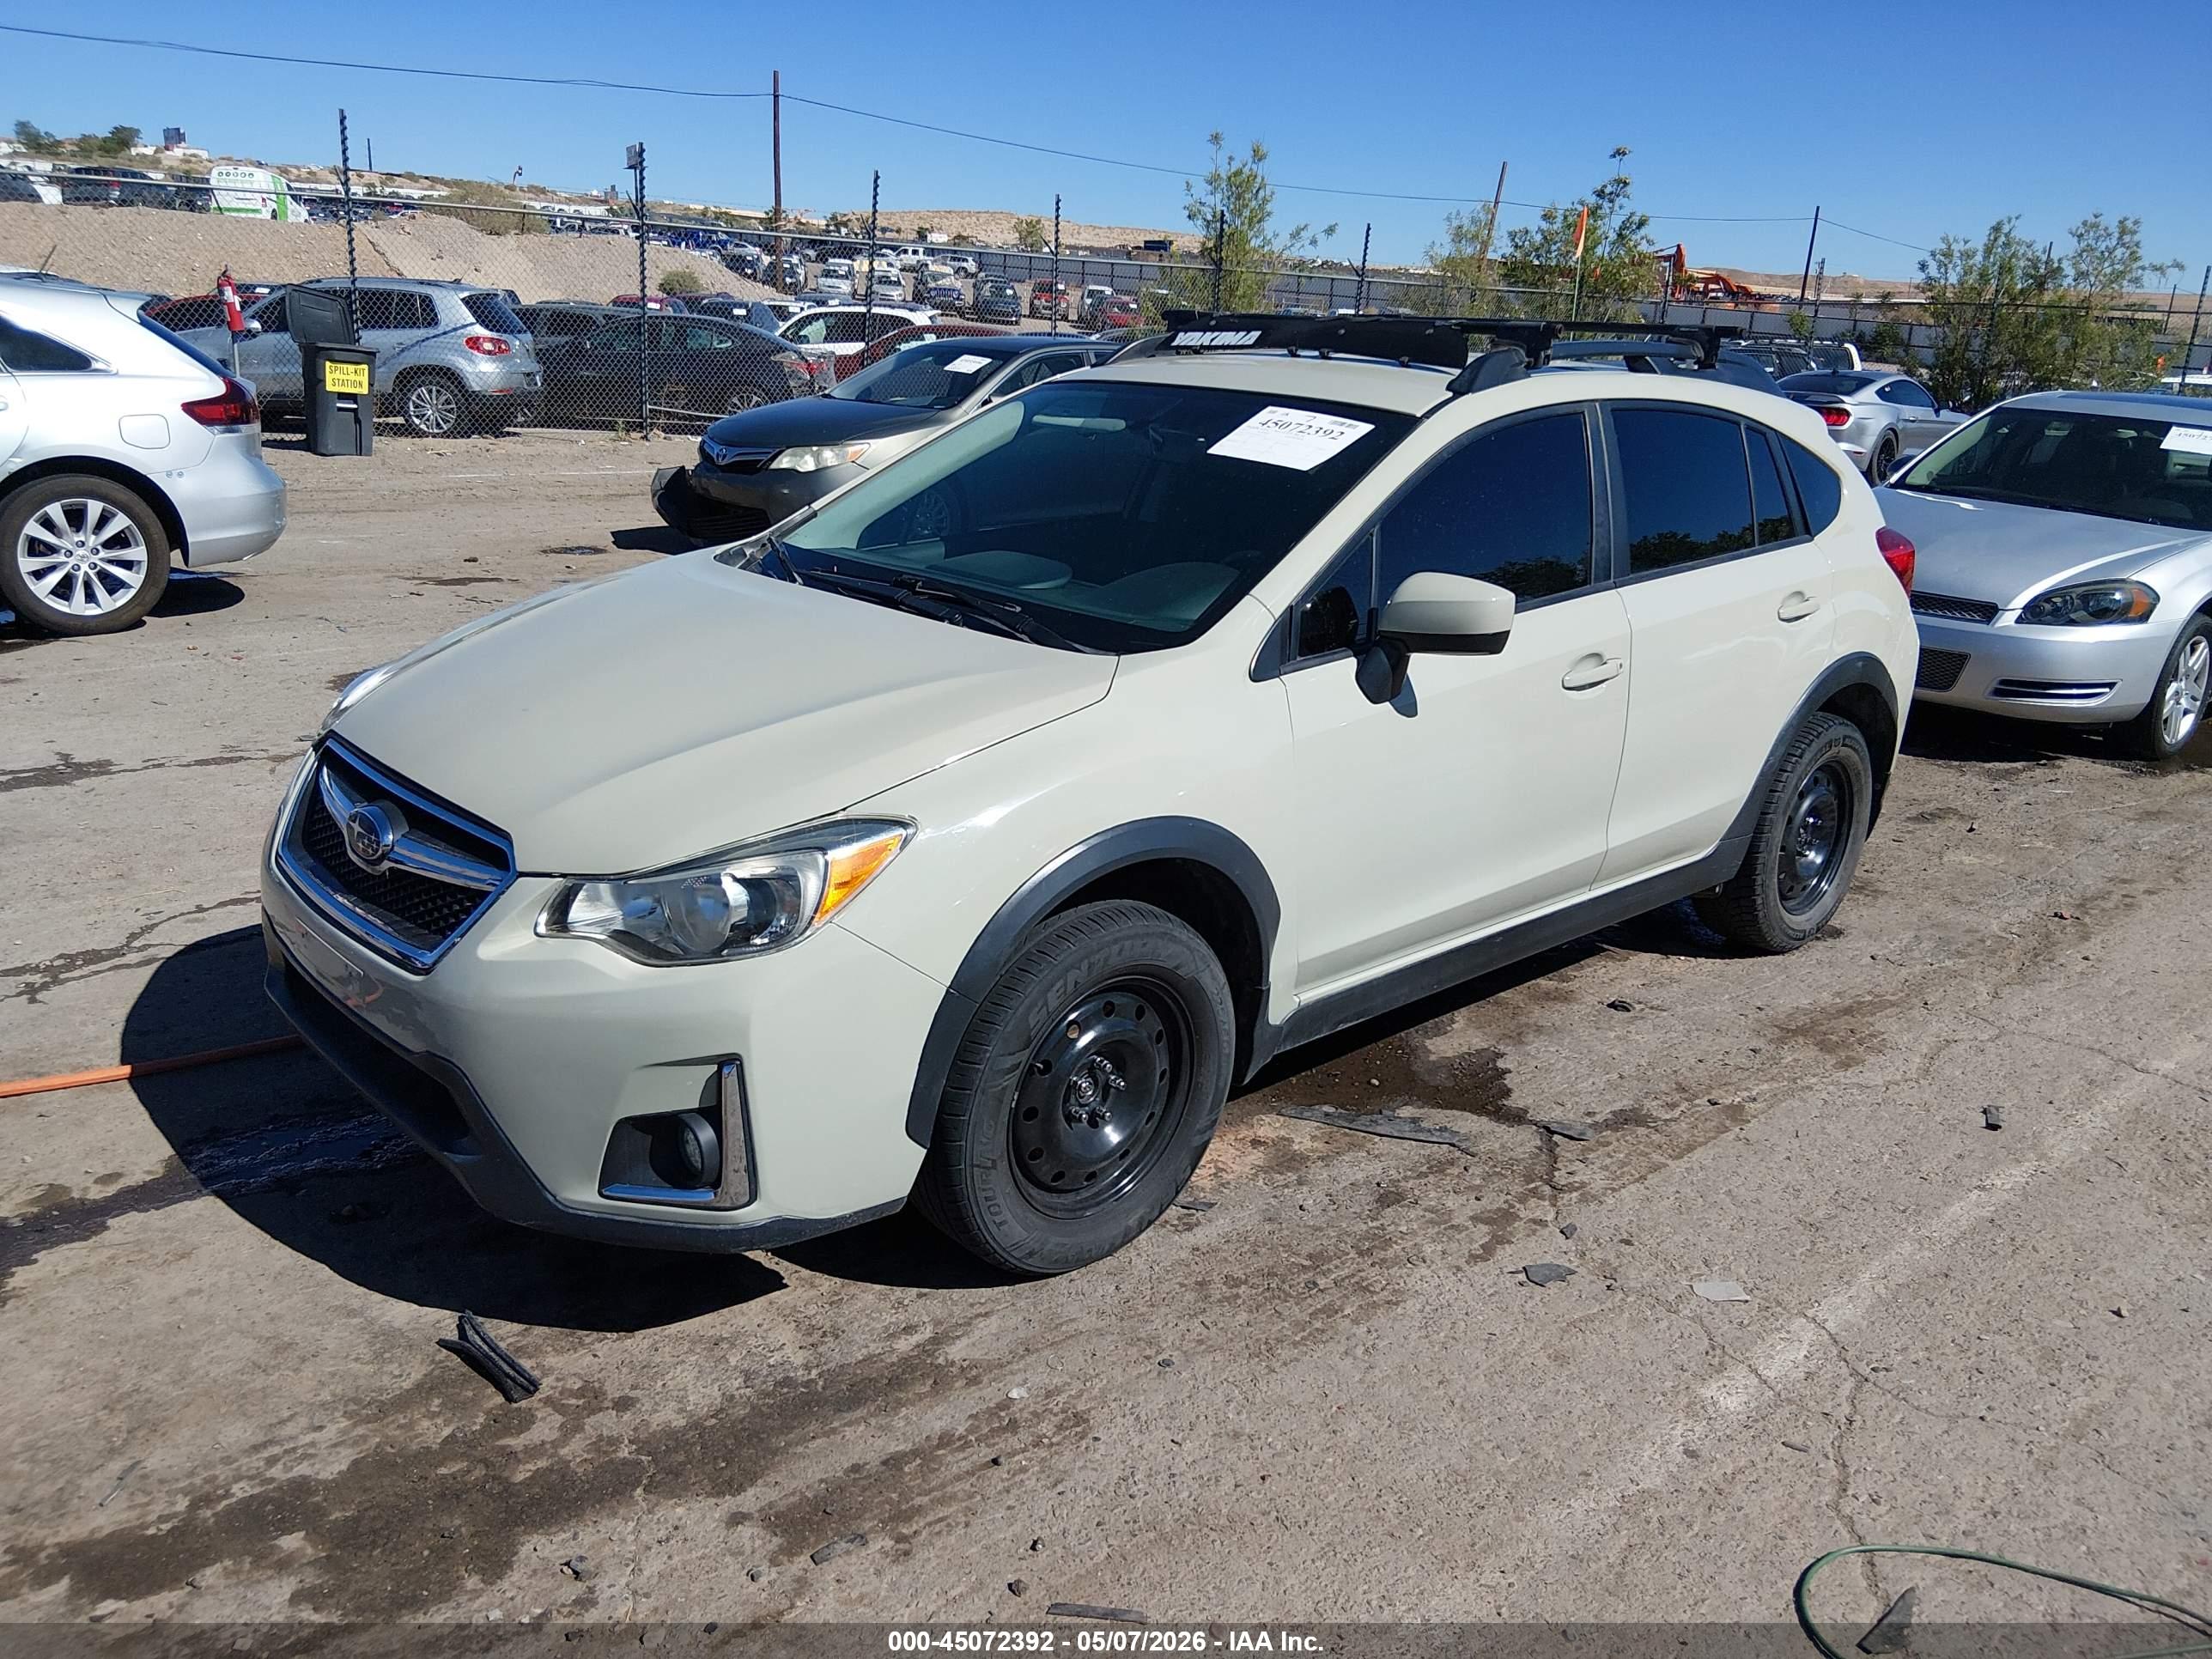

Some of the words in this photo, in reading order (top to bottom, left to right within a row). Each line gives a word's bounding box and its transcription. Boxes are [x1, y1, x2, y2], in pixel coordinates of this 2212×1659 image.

[1170, 331, 1261, 346] YAKIMA
[328, 365, 366, 377] SPILL-KIT
[331, 378, 363, 389] STATION
[1259, 418, 1346, 441] 45072392
[981, 1119, 1009, 1231] TOURING
